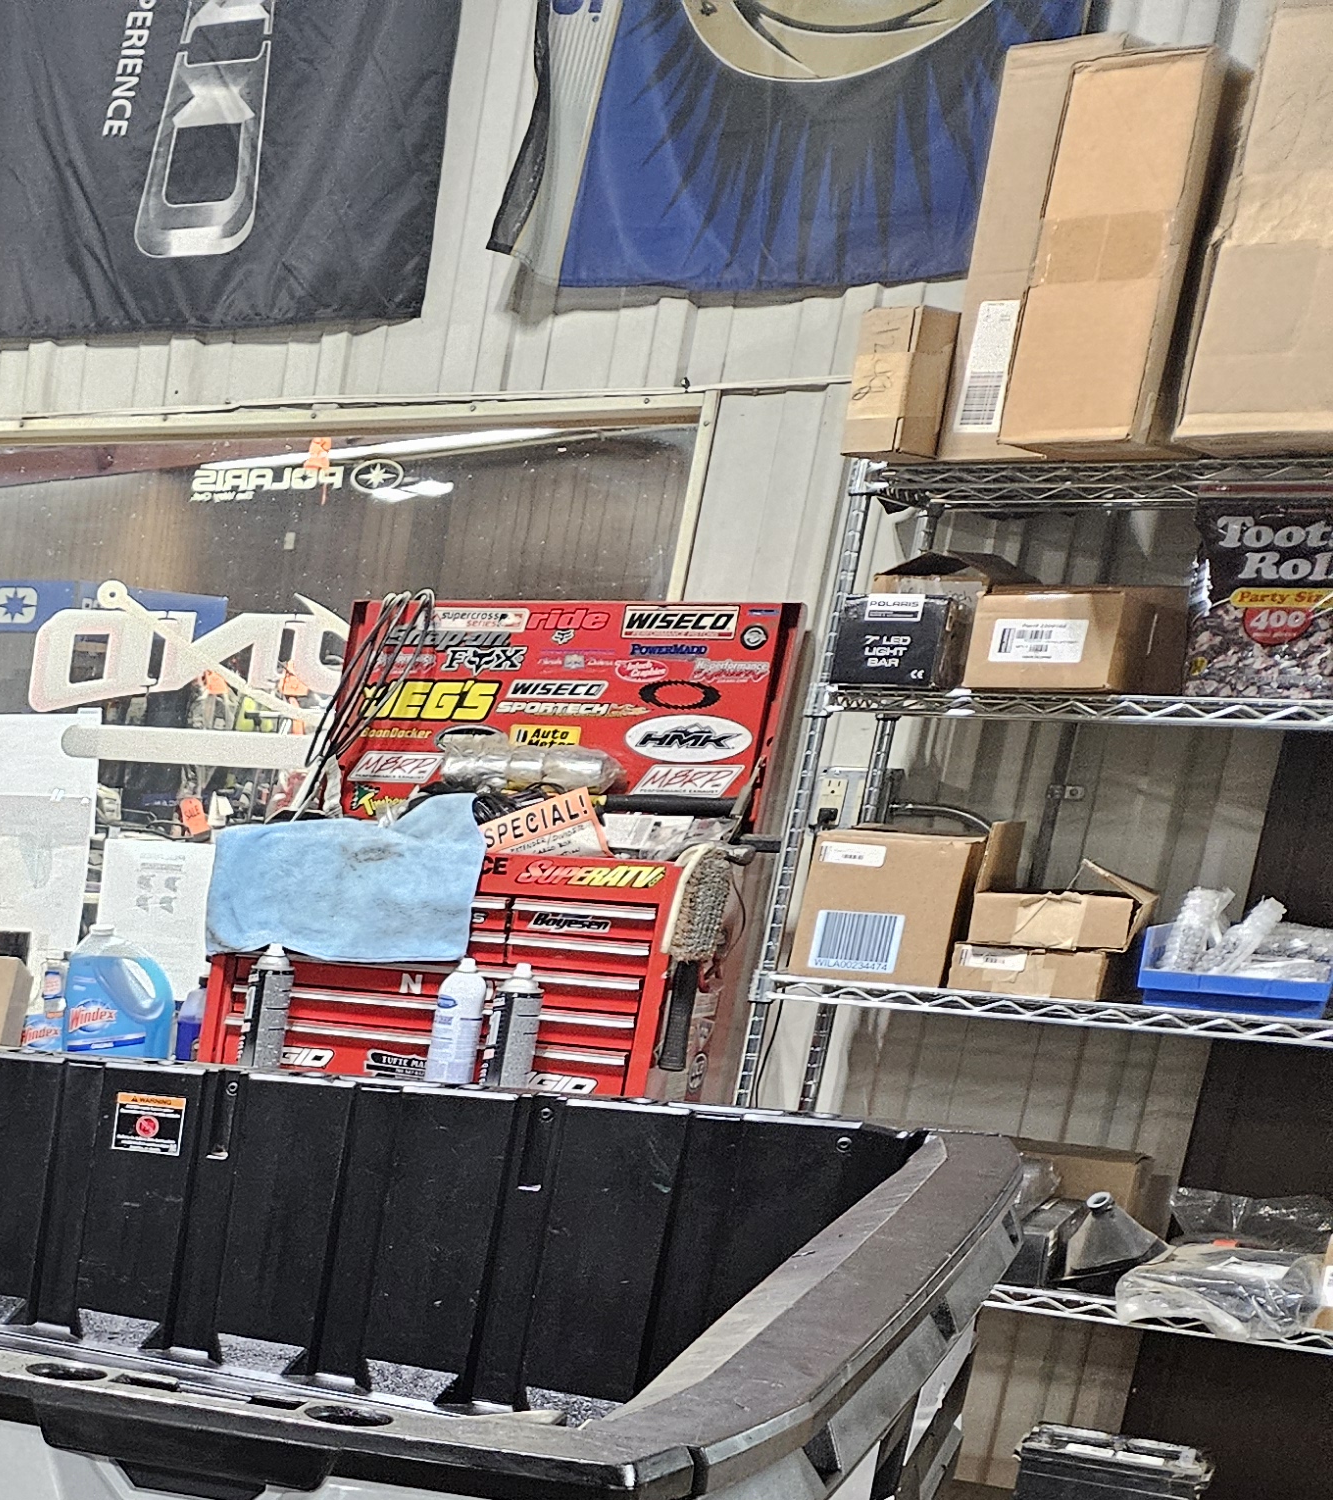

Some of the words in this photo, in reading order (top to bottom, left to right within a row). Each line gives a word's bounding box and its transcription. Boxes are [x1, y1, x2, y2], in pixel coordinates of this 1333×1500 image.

[1216, 515, 1333, 548] Toot
[869, 600, 919, 608] POLARIS
[1238, 591, 1290, 604] Party
[1295, 591, 1333, 603] Siz
[441, 611, 500, 621] supercross
[526, 608, 611, 632] ride
[625, 610, 735, 631] WISECO
[1250, 609, 1306, 631] 400
[882, 635, 911, 646] LED
[864, 646, 907, 657] LIGHT
[867, 656, 900, 668] BAR
[510, 682, 605, 697] WISECO
[496, 701, 608, 715] SPORTECH
[531, 727, 571, 739] Auto
[635, 730, 741, 749] HMK
[644, 768, 733, 787] MBRP
[183, 804, 202, 821] SALE
[483, 794, 589, 848] SPECIAL!
[532, 912, 610, 931] Boyesen
[68, 1005, 119, 1033] Windex
[281, 1047, 334, 1068] GID
[529, 1072, 598, 1093] GID
